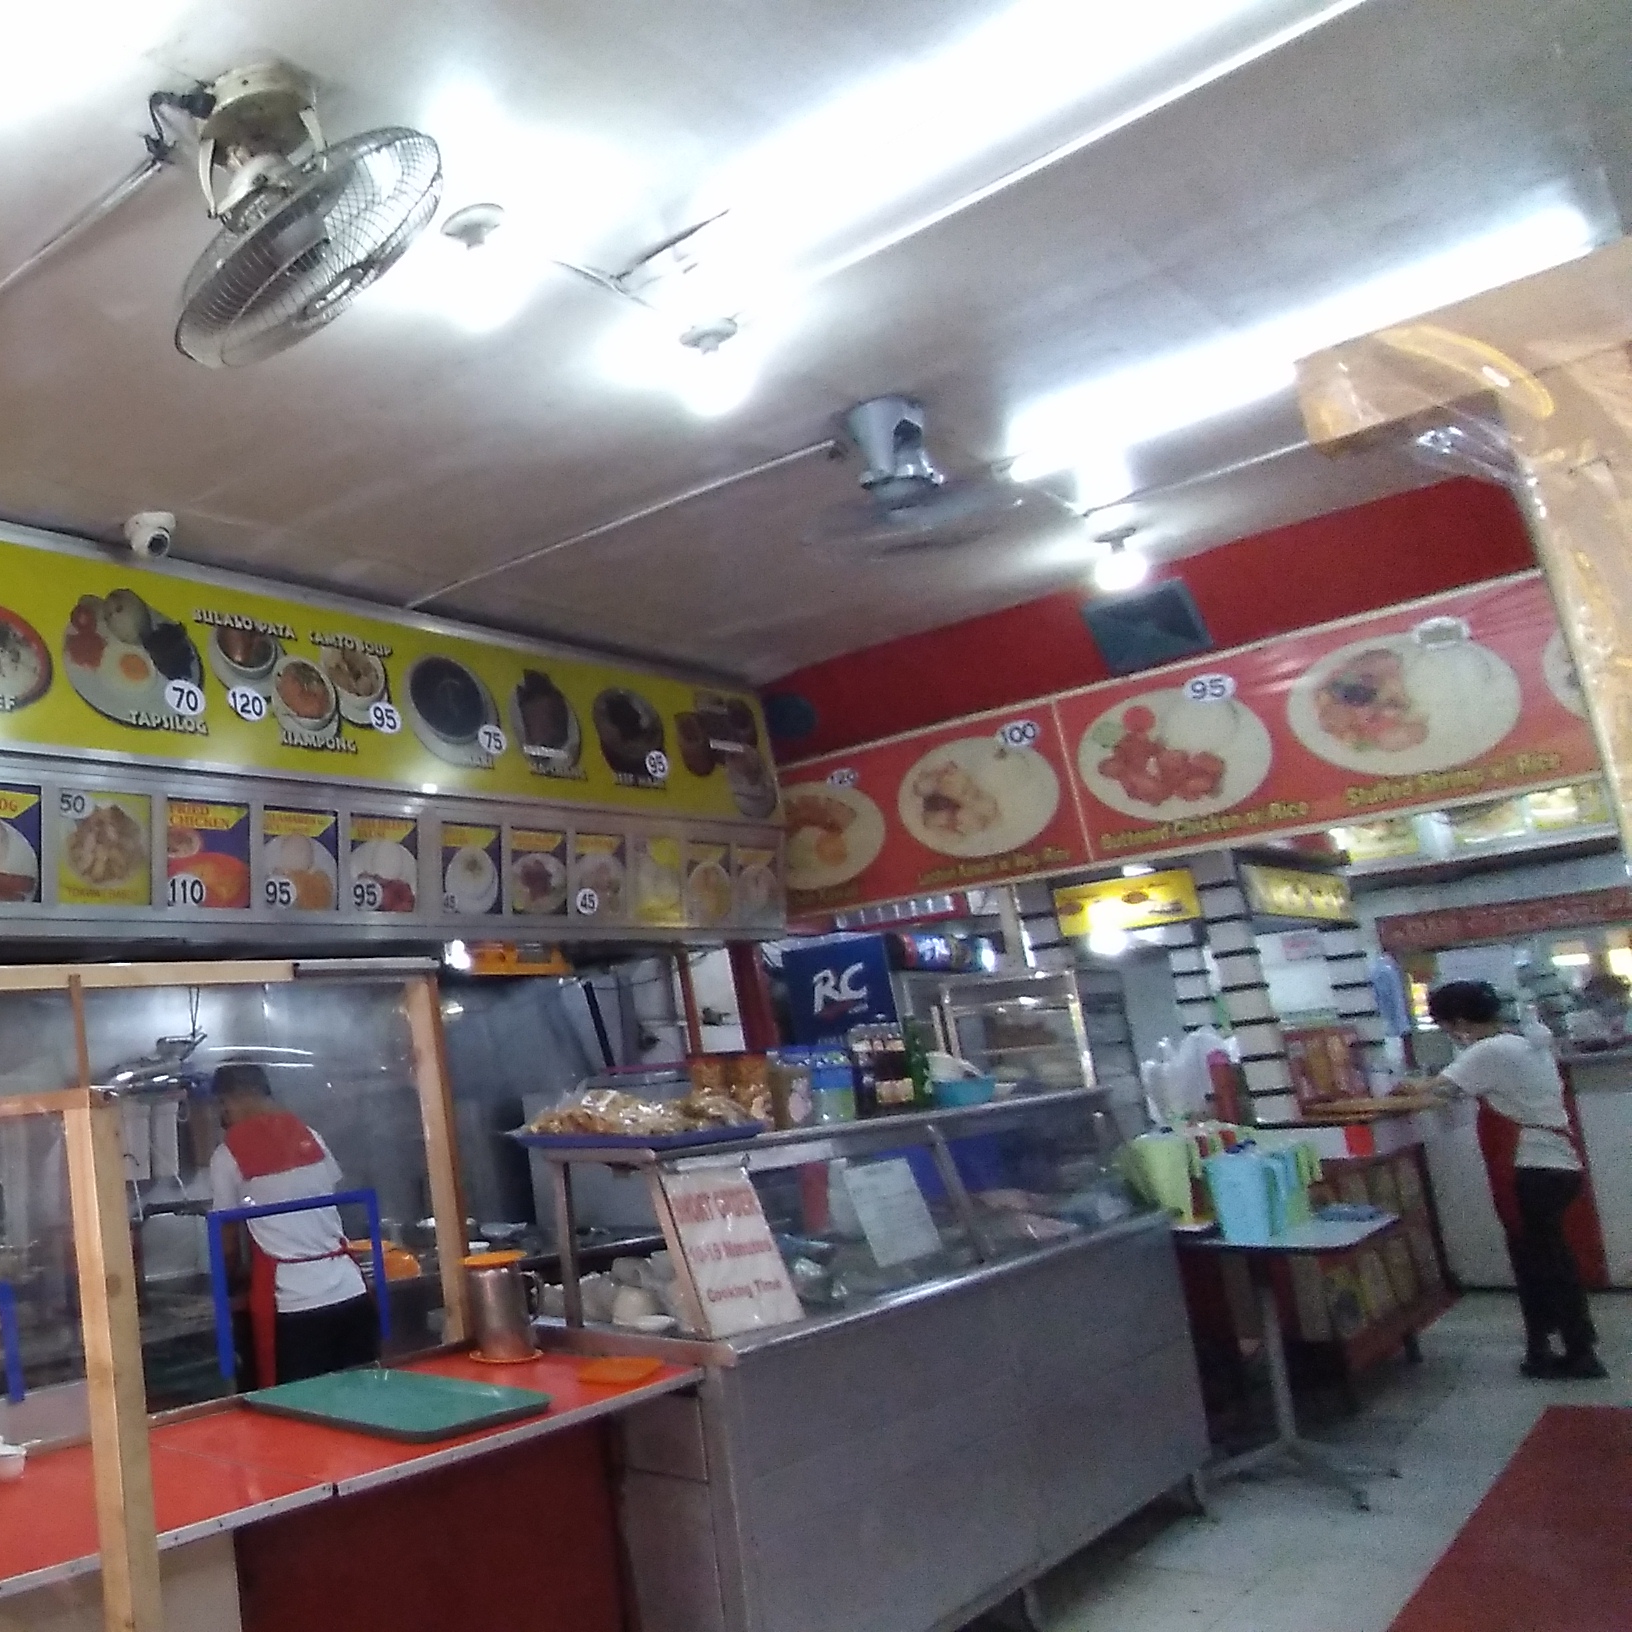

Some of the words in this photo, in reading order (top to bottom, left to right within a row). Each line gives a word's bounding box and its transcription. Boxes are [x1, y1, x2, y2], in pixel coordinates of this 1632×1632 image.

[193, 608, 254, 631] BULALO
[257, 621, 298, 641] PATA
[172, 686, 200, 711] 70
[1190, 678, 1226, 697] 95
[231, 692, 264, 717] 120
[128, 710, 209, 736] TAPSILOG
[373, 705, 397, 730] 95
[483, 731, 503, 751] 75
[999, 720, 1037, 745] 100
[648, 755, 667, 772] 95
[59, 793, 86, 814] 50
[1269, 800, 1309, 821] Rice
[170, 815, 231, 829] CHICKEN
[169, 878, 205, 904] 110
[265, 880, 292, 905] 95
[353, 883, 378, 907] 95
[580, 893, 596, 910] 45
[813, 962, 868, 1014] RC
[707, 1285, 754, 1302] Cooking
